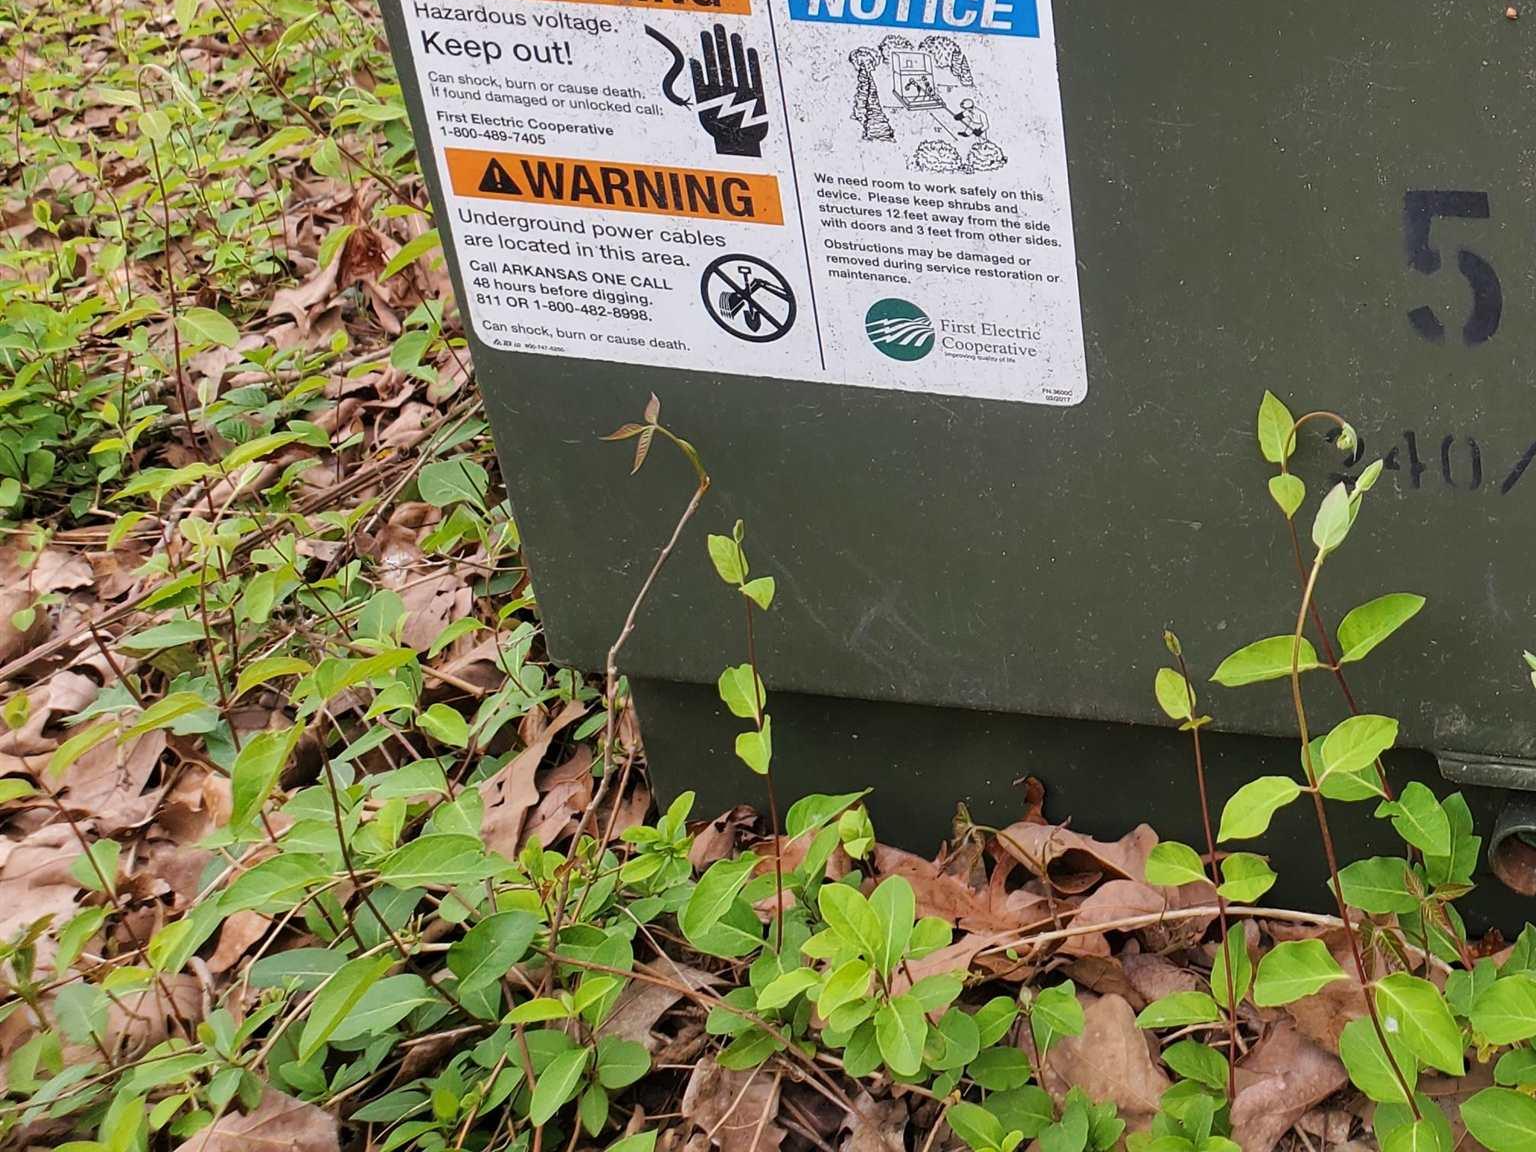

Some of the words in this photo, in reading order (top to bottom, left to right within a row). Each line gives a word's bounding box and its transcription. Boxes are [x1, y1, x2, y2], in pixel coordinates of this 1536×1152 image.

[415, 2, 527, 27] Hazardous
[533, 11, 618, 34] voltage.
[421, 31, 501, 65] Keep
[513, 41, 573, 65] out!
[429, 71, 454, 85] Can
[458, 74, 501, 89] shock,
[505, 78, 536, 91] burn
[541, 83, 554, 92] or
[558, 84, 598, 96] cause
[602, 85, 645, 99] death.
[431, 86, 440, 98] If
[443, 87, 482, 102] found
[486, 90, 547, 110] damaged
[551, 97, 564, 107] or
[569, 95, 631, 113] unlocked
[635, 102, 663, 116] call:
[437, 111, 467, 125] First
[472, 114, 523, 130] Electric
[528, 119, 614, 136] Cooperative
[441, 126, 546, 145] 1-800-489-7405
[521, 159, 754, 217] WARNING
[815, 172, 834, 184] We
[837, 176, 868, 187] need
[872, 179, 904, 189] room
[908, 181, 921, 191] to
[924, 183, 956, 195] work
[960, 185, 997, 200] safely
[1001, 190, 1016, 199] on
[1021, 190, 1043, 202] this
[817, 189, 861, 201] device.
[868, 192, 909, 205] Please
[914, 196, 944, 209] keep
[948, 198, 991, 212] shrubs
[995, 202, 1018, 214] and
[459, 208, 585, 235] Underground
[592, 223, 654, 243] power
[660, 228, 726, 247] cables
[819, 204, 882, 218] structures
[886, 208, 900, 218] 12
[904, 209, 928, 221] feet
[932, 214, 964, 226] away
[968, 215, 998, 227] from
[1001, 218, 1021, 229] the
[1025, 220, 1050, 231] side
[821, 218, 847, 229] with
[851, 220, 886, 232] doors
[890, 223, 913, 234] and
[917, 225, 924, 234] 3
[927, 226, 952, 238] feet
[955, 228, 984, 240] from
[988, 232, 1021, 244] other
[1025, 236, 1061, 247] sides.
[464, 235, 492, 248] are
[498, 234, 570, 255] located
[577, 243, 594, 257] in
[600, 245, 635, 262] this
[642, 252, 690, 267] area.
[824, 239, 904, 254] Obstructions
[908, 248, 933, 258] may
[937, 249, 952, 259] be
[957, 250, 1014, 265] damaged
[1018, 256, 1031, 265] or
[470, 260, 496, 273] Call
[502, 263, 587, 282] ARKANSAS
[591, 272, 626, 285] ONE
[631, 276, 672, 290] CALL
[826, 254, 879, 267] removed
[884, 258, 923, 273] during
[926, 263, 971, 274] service
[975, 266, 1042, 281] restoration
[1047, 273, 1060, 283] or
[828, 269, 911, 284] maintenance.
[473, 277, 490, 289] 48
[494, 280, 535, 294] hours
[540, 283, 588, 299] before
[592, 289, 653, 306] digging.
[477, 293, 501, 305] 811
[506, 295, 529, 308] OR
[534, 299, 652, 321] 1-800-482-8998.
[482, 319, 507, 332] Can
[512, 322, 552, 338] shock,
[557, 327, 586, 340] burn
[591, 332, 603, 341] or
[607, 333, 645, 346] cause
[650, 337, 690, 351] death.
[941, 320, 976, 334] First
[982, 323, 1040, 340] Electric
[942, 337, 1037, 357] Cooperative
